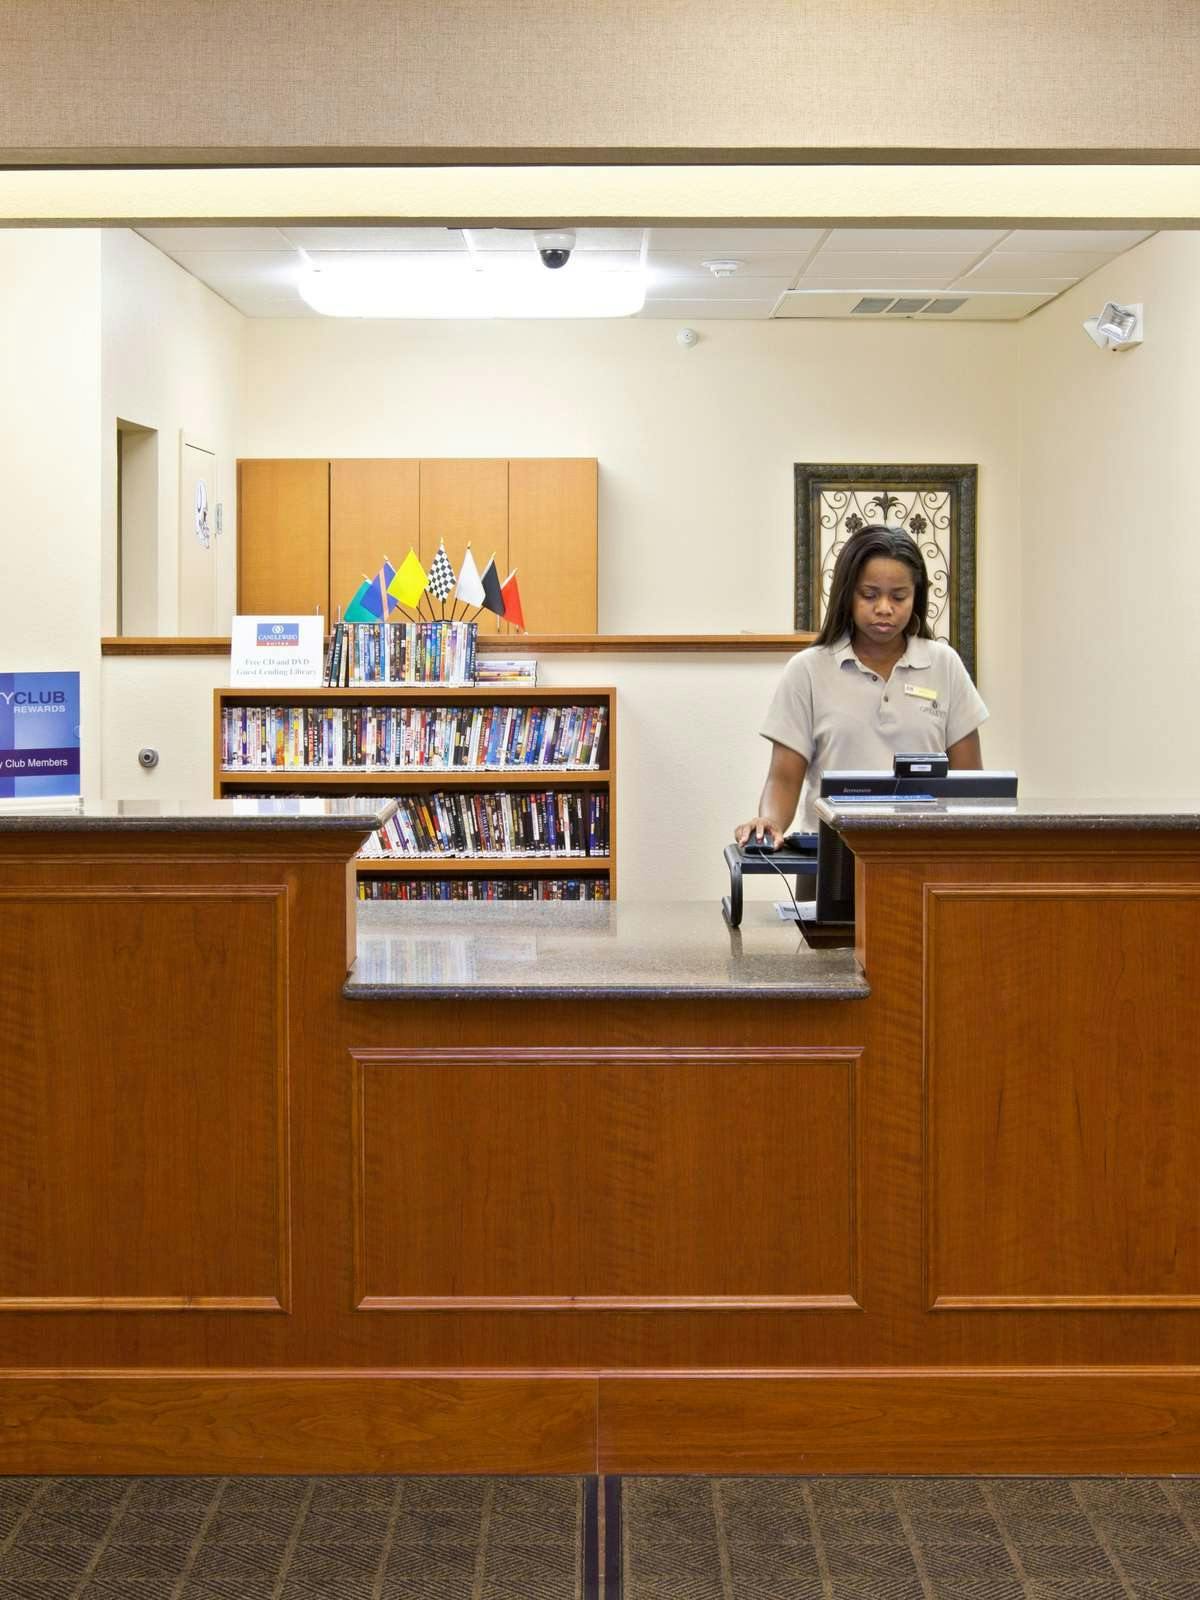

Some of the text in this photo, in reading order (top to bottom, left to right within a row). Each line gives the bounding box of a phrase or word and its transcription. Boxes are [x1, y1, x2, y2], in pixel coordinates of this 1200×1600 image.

[0, 691, 65, 704] YCLUB
[14, 705, 66, 713] REWARDS
[5, 759, 26, 768] Club
[27, 758, 68, 767] Members
